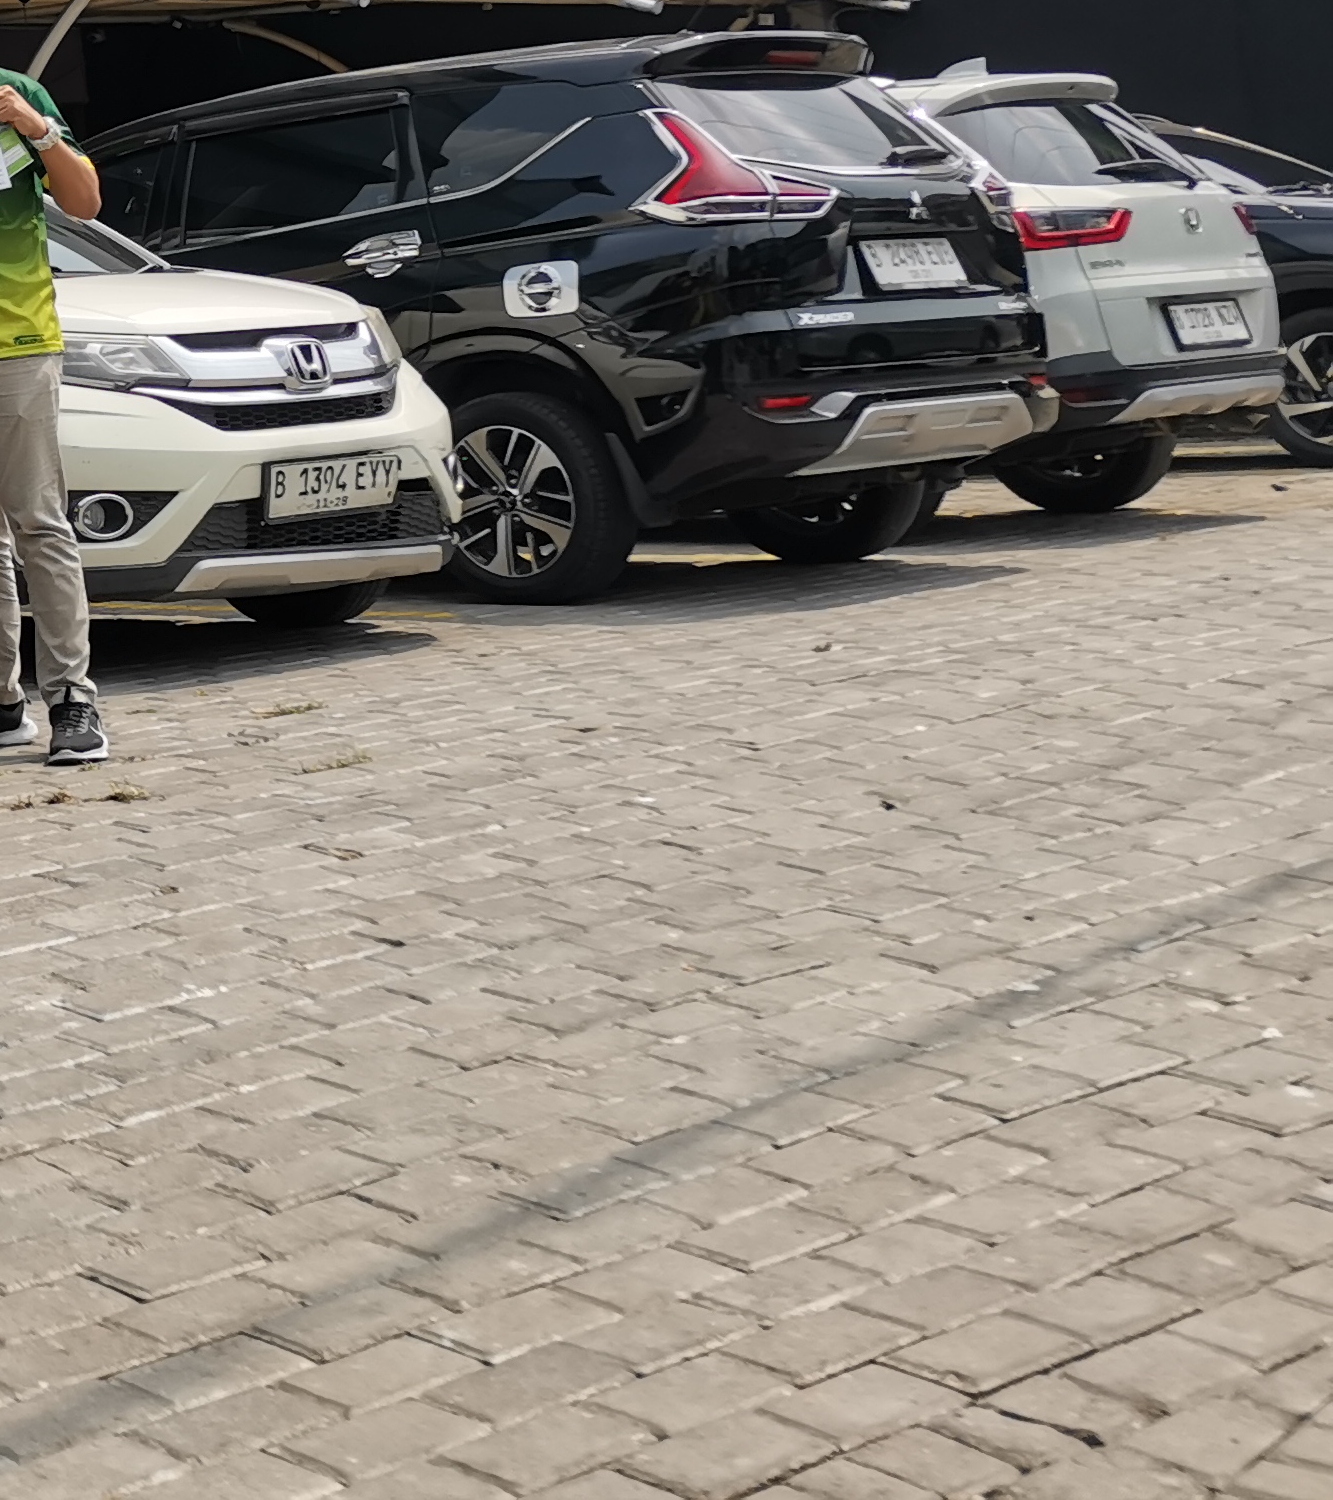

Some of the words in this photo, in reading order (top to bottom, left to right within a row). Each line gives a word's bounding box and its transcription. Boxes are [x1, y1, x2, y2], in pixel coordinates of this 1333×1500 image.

[275, 470, 286, 498] B
[298, 464, 347, 496] 1394
[355, 460, 394, 490] EYY
